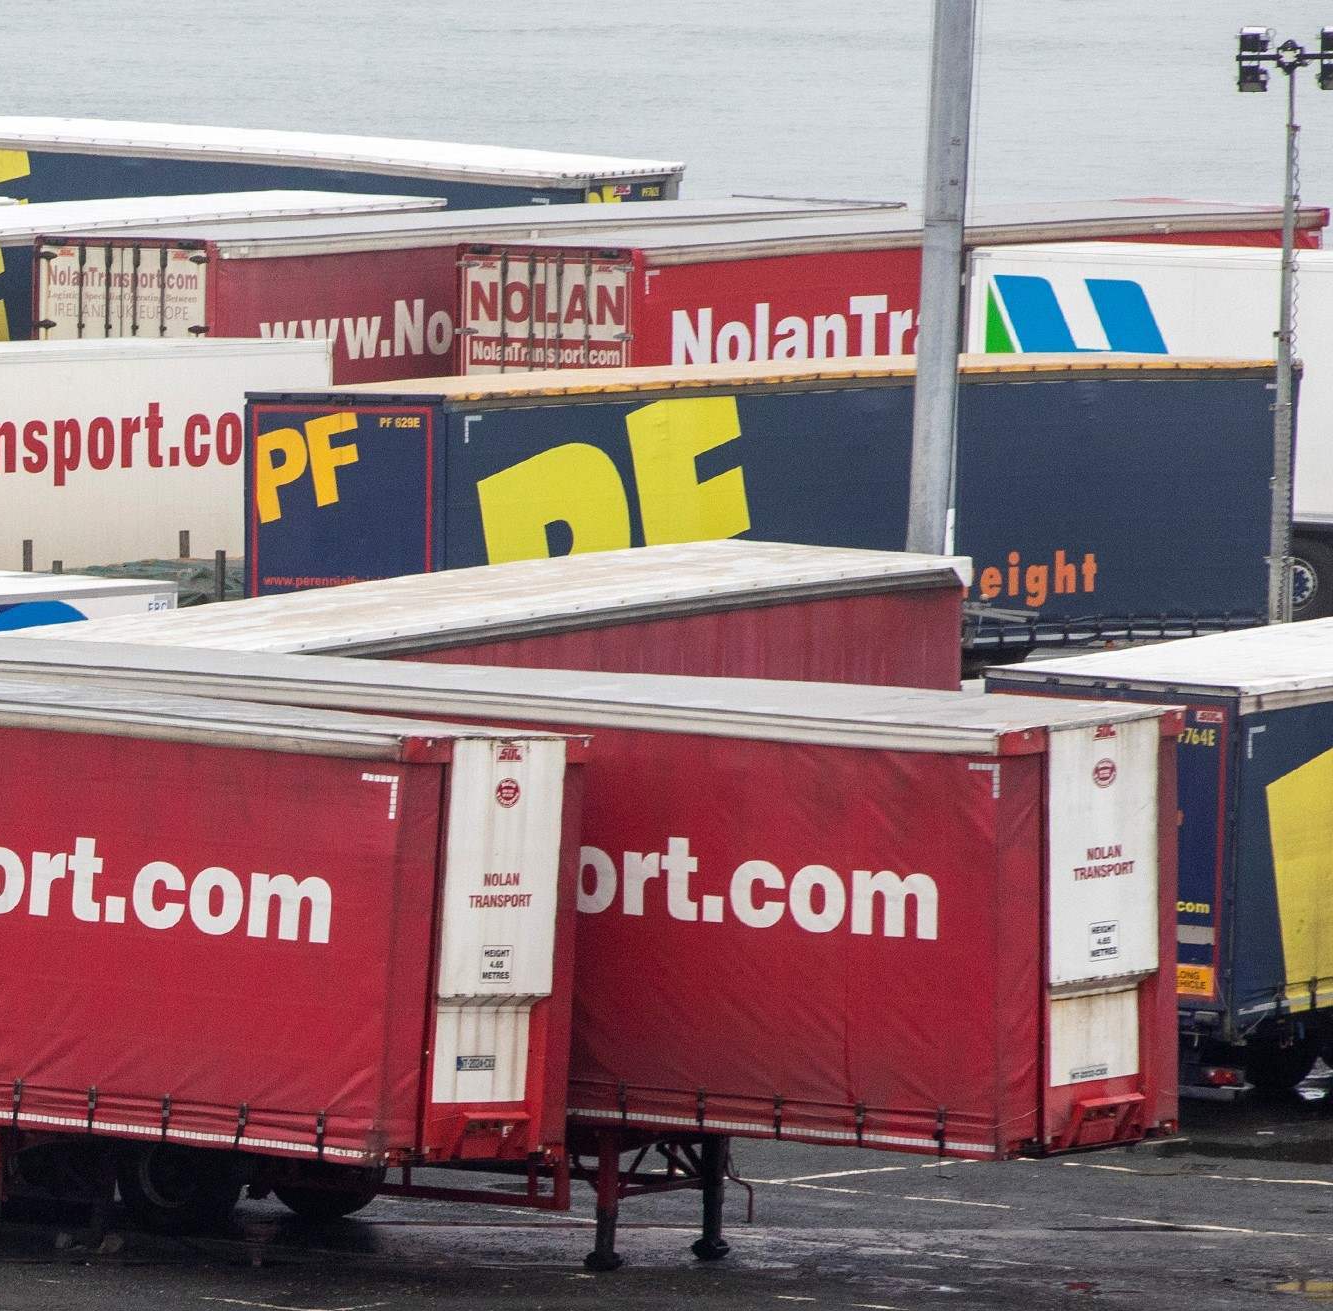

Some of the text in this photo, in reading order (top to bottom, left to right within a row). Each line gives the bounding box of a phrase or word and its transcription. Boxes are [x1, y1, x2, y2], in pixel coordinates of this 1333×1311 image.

[471, 281, 626, 326] NOLAN
[257, 412, 359, 524] PF
[1086, 844, 1122, 861] NOLAN
[483, 873, 520, 887] NOLAN
[1073, 860, 1135, 881] TRANSPORT
[469, 894, 532, 909] TRANSPORT
